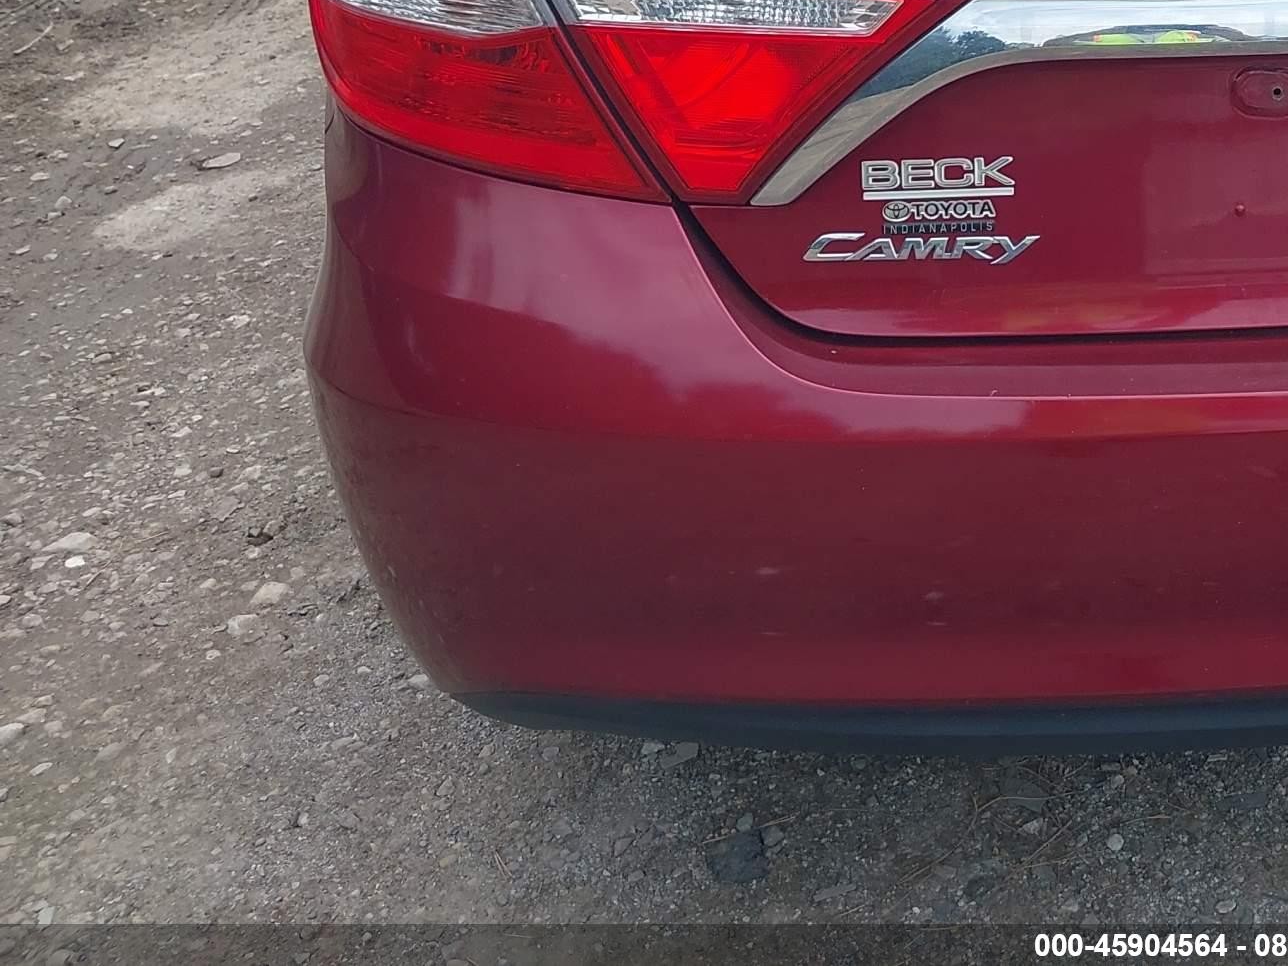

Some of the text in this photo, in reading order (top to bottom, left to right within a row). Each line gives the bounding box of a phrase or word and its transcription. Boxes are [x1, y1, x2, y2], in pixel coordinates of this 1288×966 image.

[861, 156, 1015, 189] BECK
[911, 201, 995, 220] TOYOTA
[882, 222, 994, 234] INDIANAPOLIS
[803, 233, 1041, 265] CAMRY
